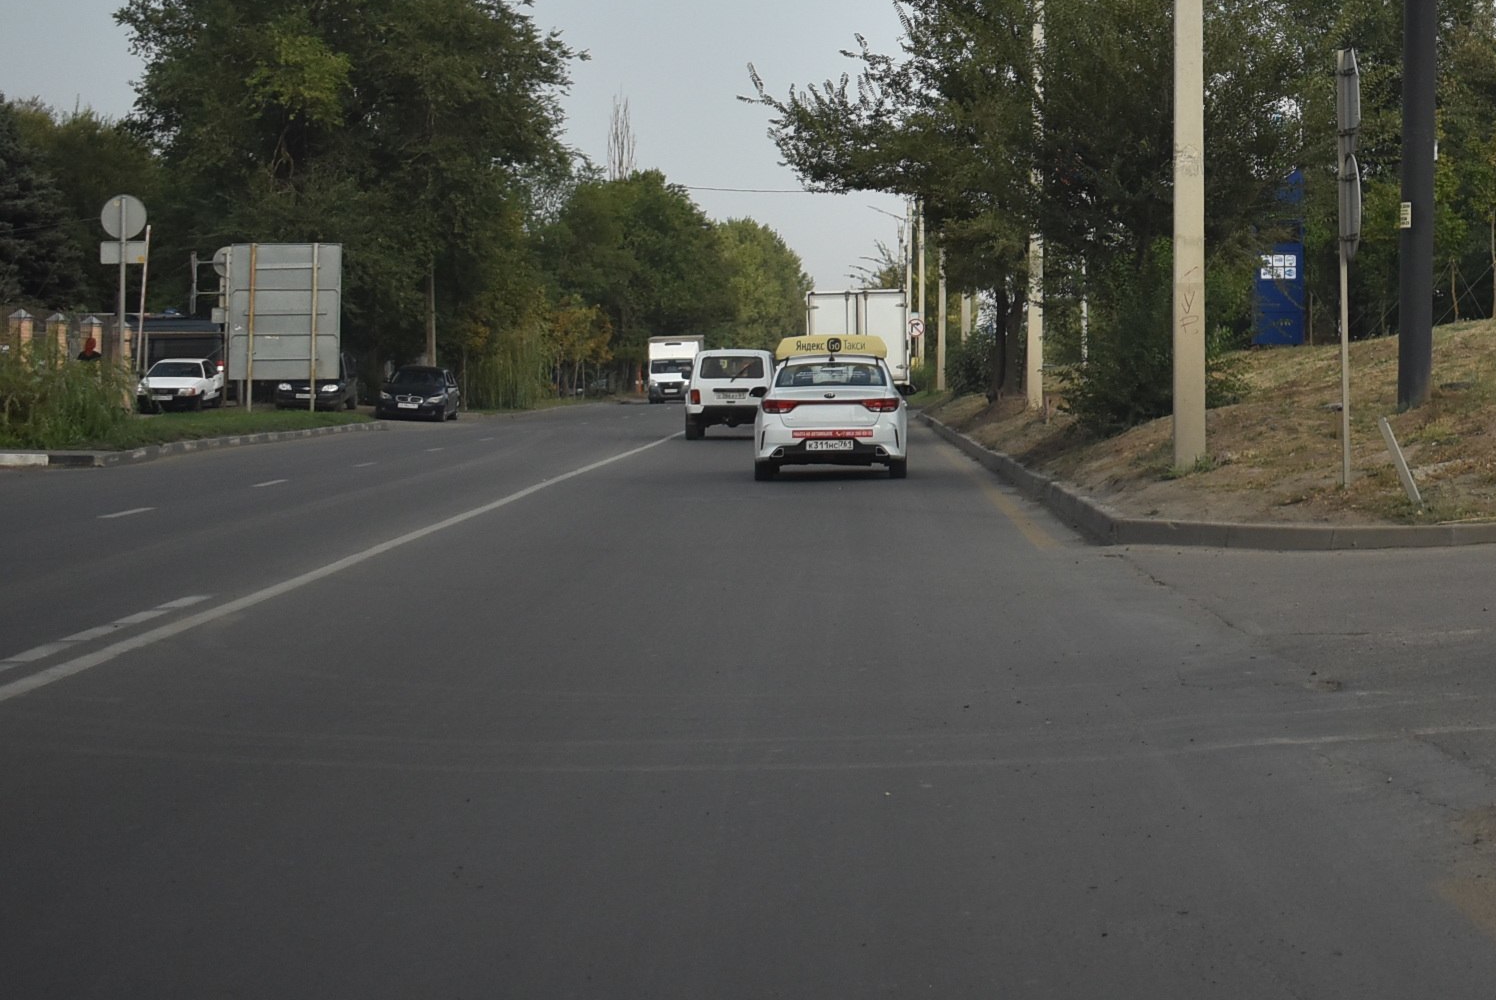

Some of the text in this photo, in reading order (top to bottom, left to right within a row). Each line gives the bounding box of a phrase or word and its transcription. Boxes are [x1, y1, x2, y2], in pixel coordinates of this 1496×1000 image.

[796, 340, 866, 352] Яндекс Go Такси
